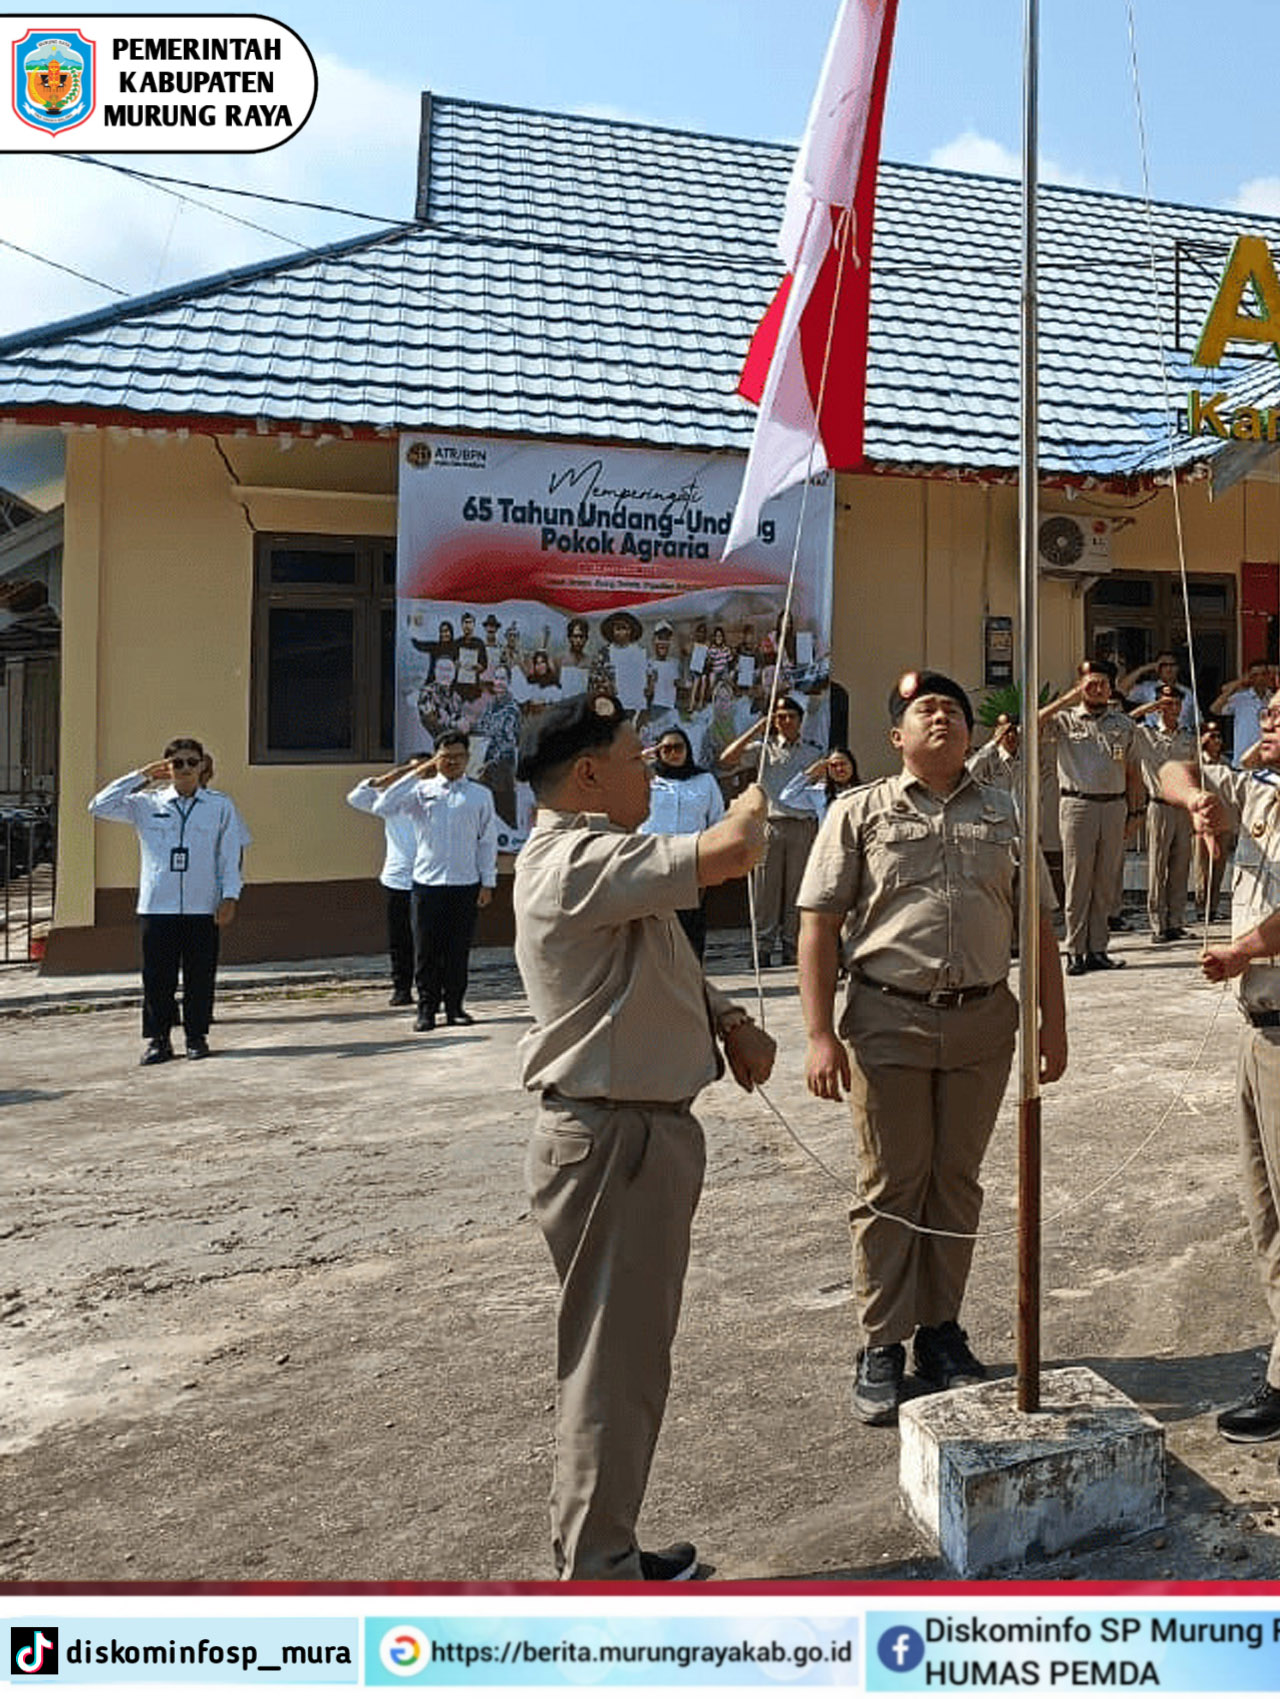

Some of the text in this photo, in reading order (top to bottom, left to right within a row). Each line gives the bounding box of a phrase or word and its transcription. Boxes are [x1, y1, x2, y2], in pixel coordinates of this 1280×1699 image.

[434, 447, 487, 461] ATR/BPN
[462, 496, 776, 545] 65 Tahun Undang-Undg
[541, 527, 711, 563] Pokok Agraria
